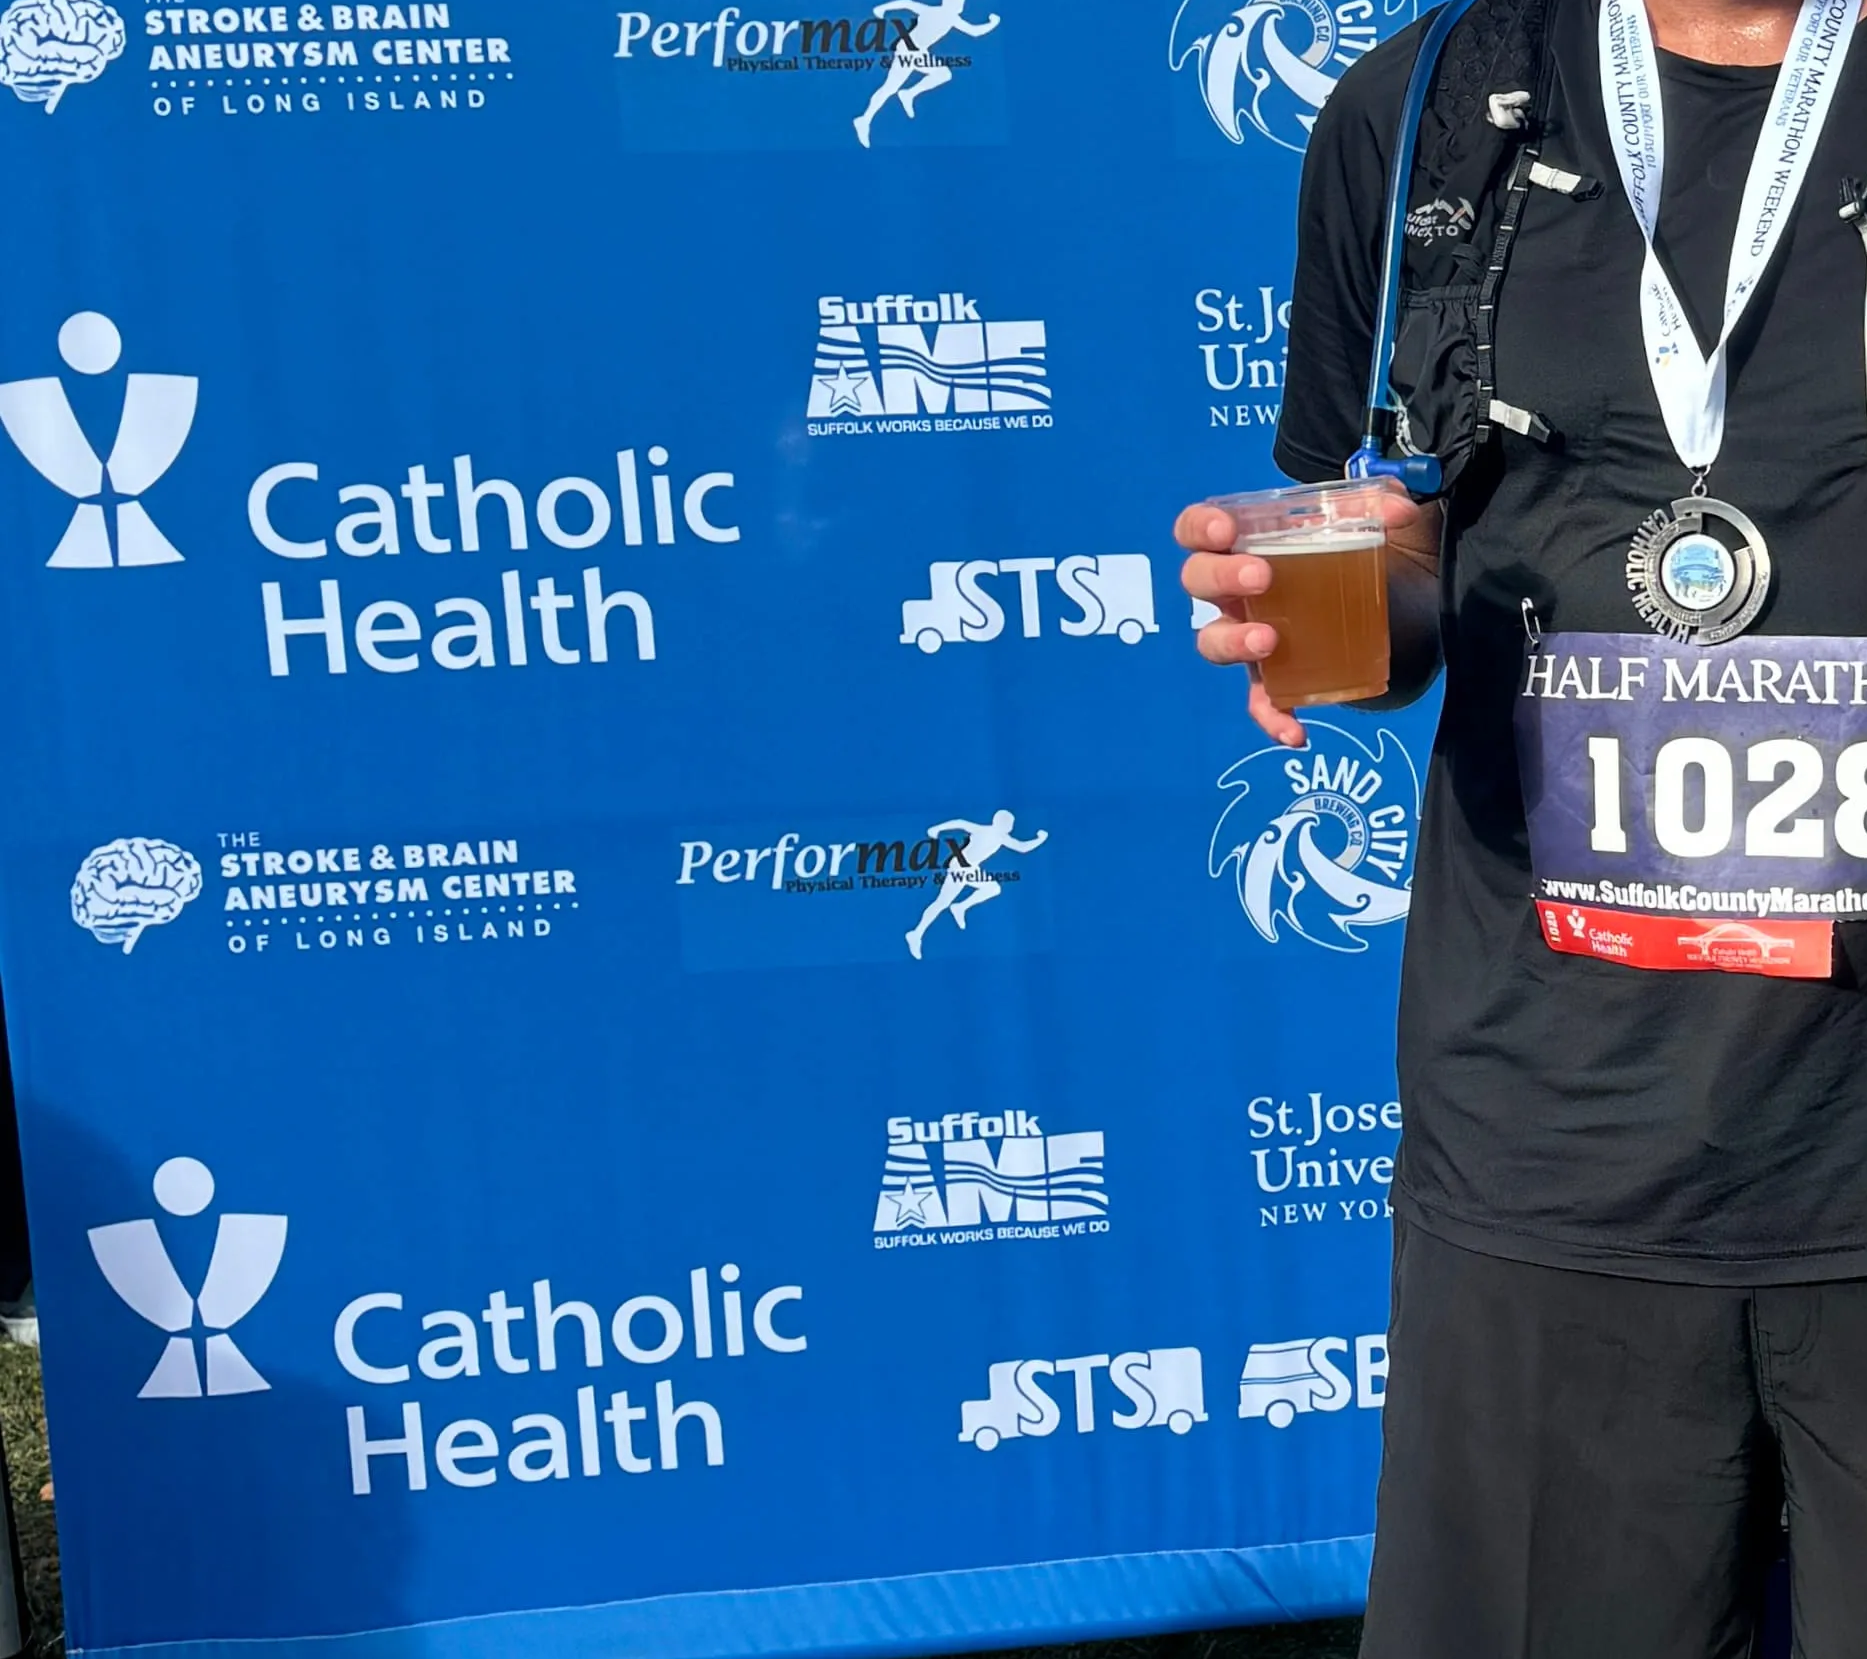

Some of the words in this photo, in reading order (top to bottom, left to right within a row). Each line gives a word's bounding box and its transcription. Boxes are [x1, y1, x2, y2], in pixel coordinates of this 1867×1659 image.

[145, 6, 289, 36] STROKE
[297, 3, 325, 32] &
[331, 3, 450, 31] BRAIN
[613, 5, 918, 69] Performax
[149, 40, 359, 71] ANEURYSM
[372, 38, 511, 66] CENTER
[153, 96, 195, 117] OF
[222, 93, 321, 114] LONG
[347, 89, 485, 111] ISLAND
[1617, 80, 1640, 145] COUNTY
[1779, 67, 1824, 164] MARATHON
[1751, 169, 1791, 256] WEEKEND
[818, 292, 981, 325] Suffolk
[247, 445, 741, 559] Catholic
[1625, 508, 1671, 592] CATHOLIC
[261, 567, 656, 677] Health
[1631, 593, 1690, 645] HEALTH
[1521, 653, 1649, 703] HALF
[1284, 754, 1385, 807] SAND
[1365, 804, 1408, 881] CITY
[220, 847, 361, 878] STROKE
[369, 844, 397, 871] &
[403, 839, 518, 869] BRAIN
[676, 831, 971, 891] Performax
[224, 877, 429, 911] ANEURYSM
[442, 870, 577, 900] CENTER
[887, 1109, 1043, 1145] Suffolk
[334, 1263, 807, 1384] Catholic
[346, 1379, 724, 1495] Health
